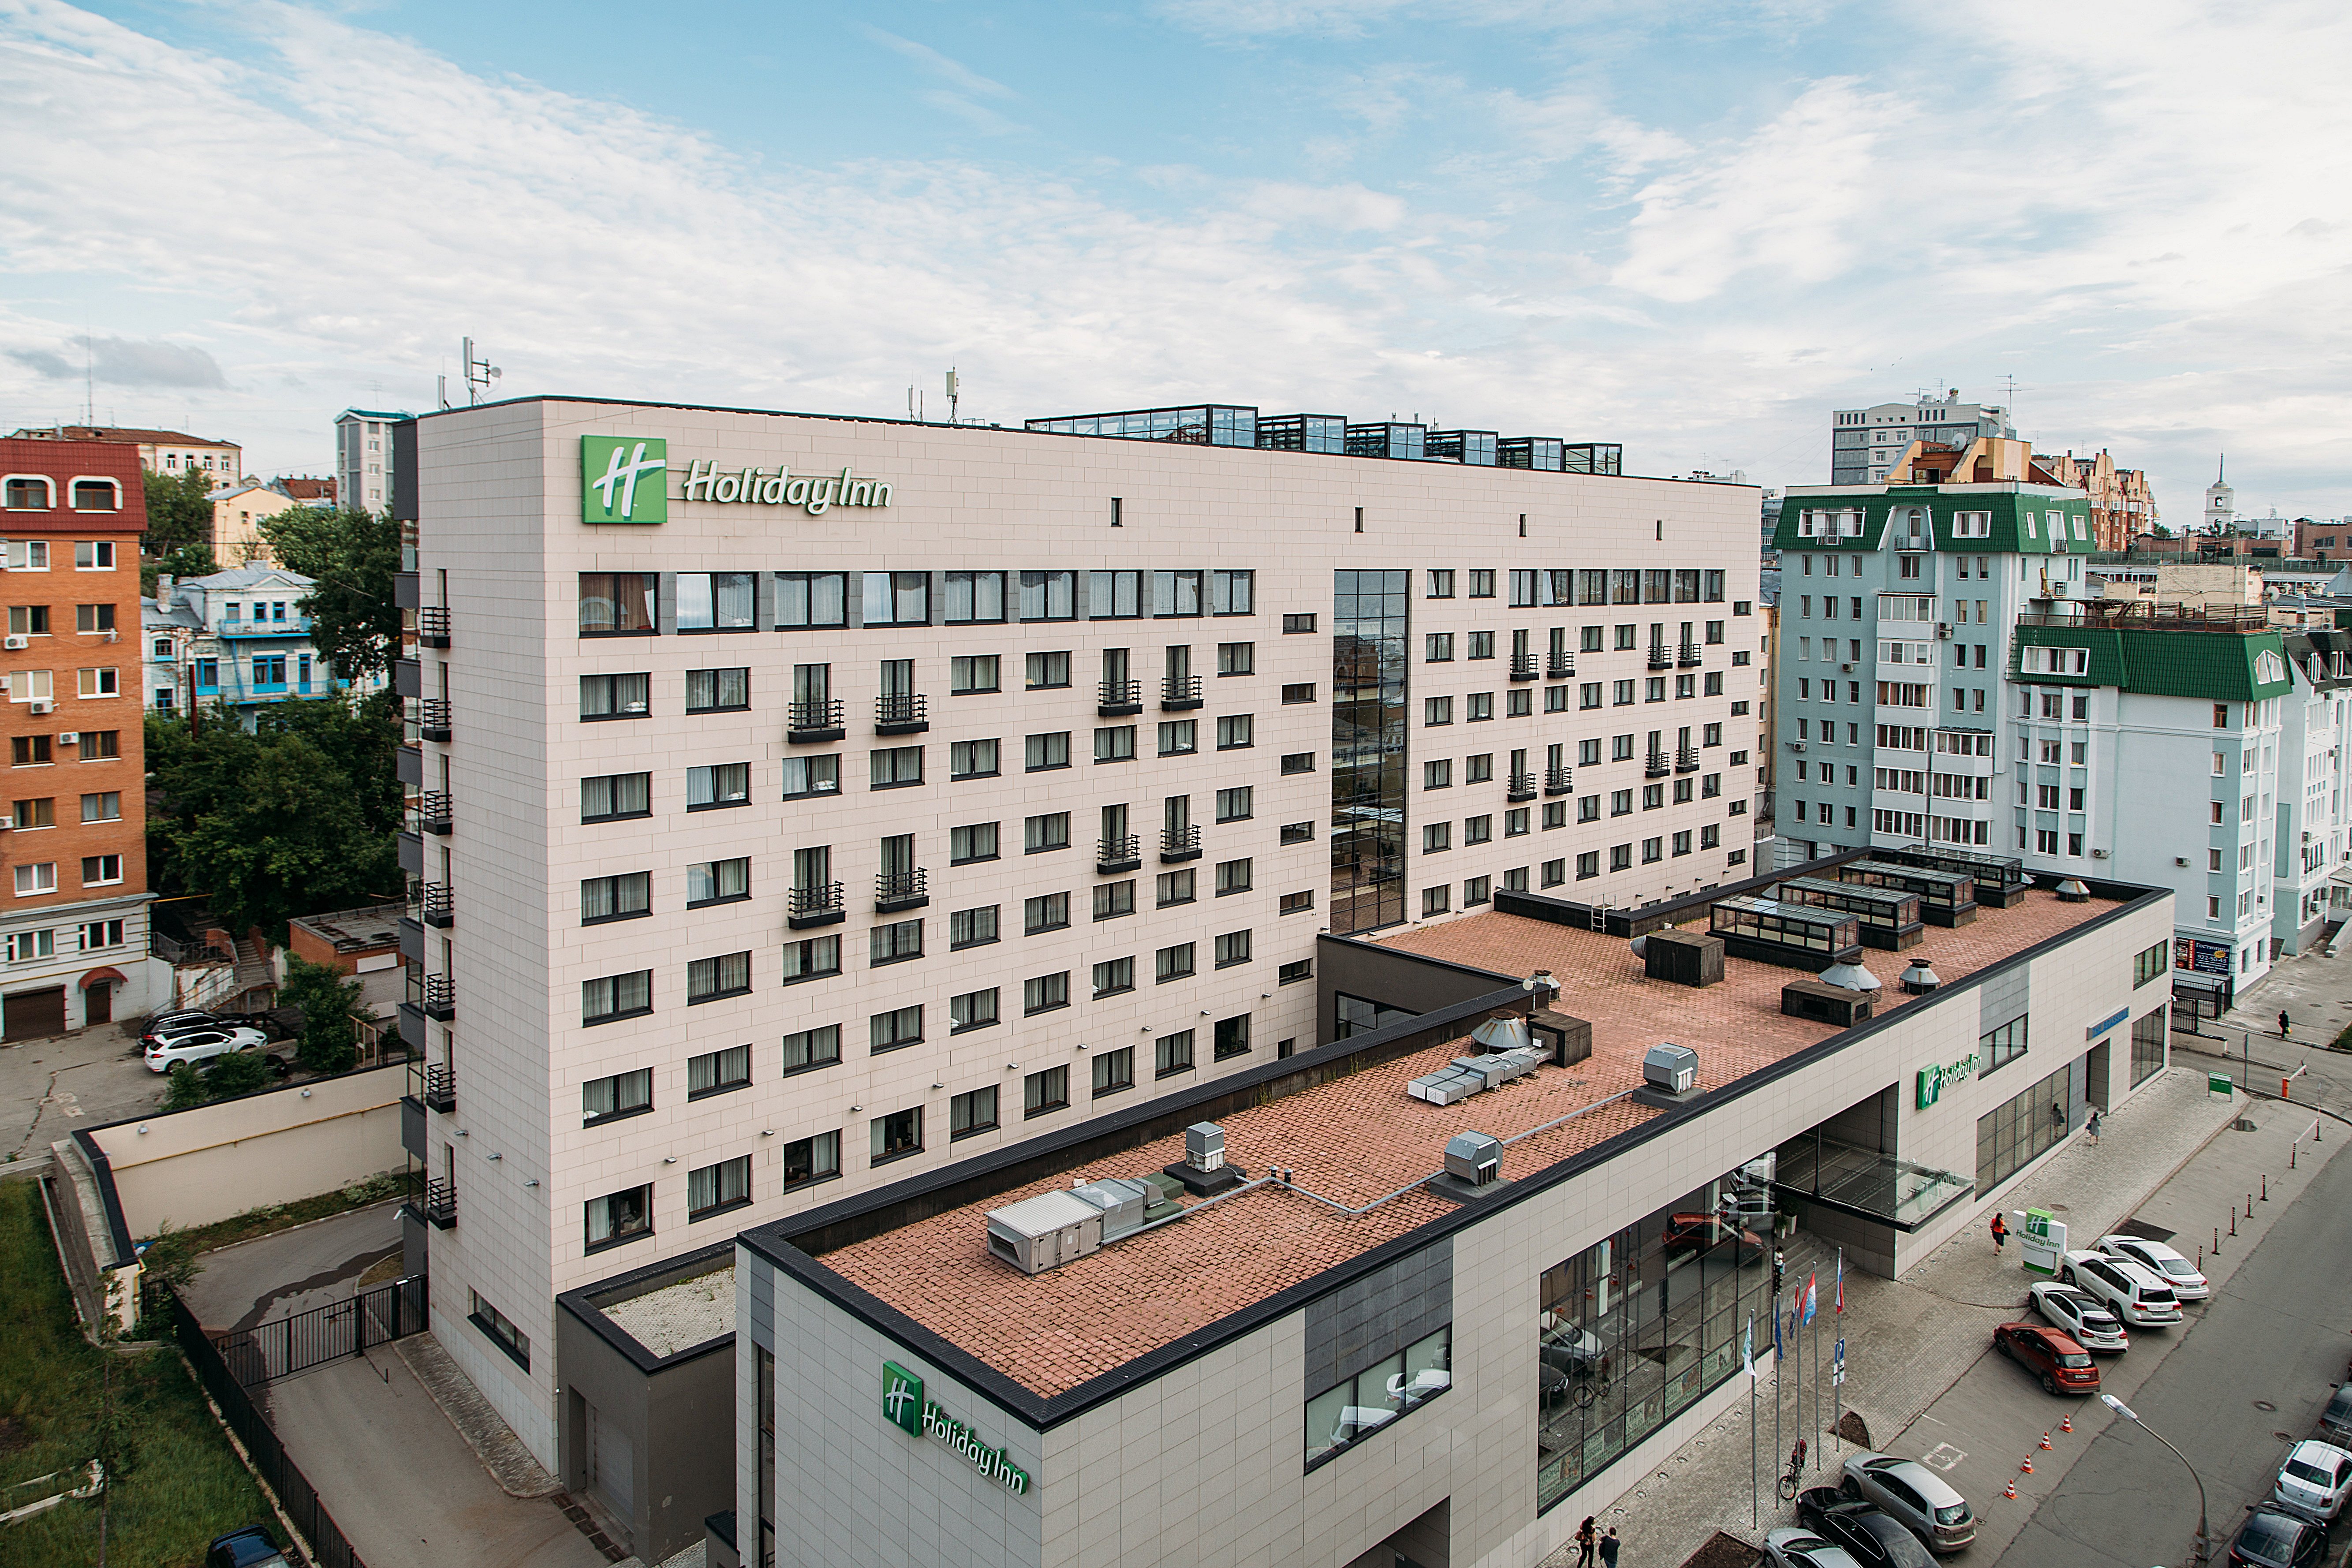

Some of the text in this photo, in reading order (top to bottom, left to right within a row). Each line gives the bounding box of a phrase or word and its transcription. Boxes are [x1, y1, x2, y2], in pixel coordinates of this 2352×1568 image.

[683, 459, 894, 515] Holiday Inn
[2196, 942, 2229, 952] Гостиница
[2197, 954, 2226, 963] 922-50-43
[1938, 1054, 1982, 1090] Holiday Inn
[2016, 1229, 2060, 1248] Holiday Inn
[922, 1400, 1028, 1495] Holiday Inn
